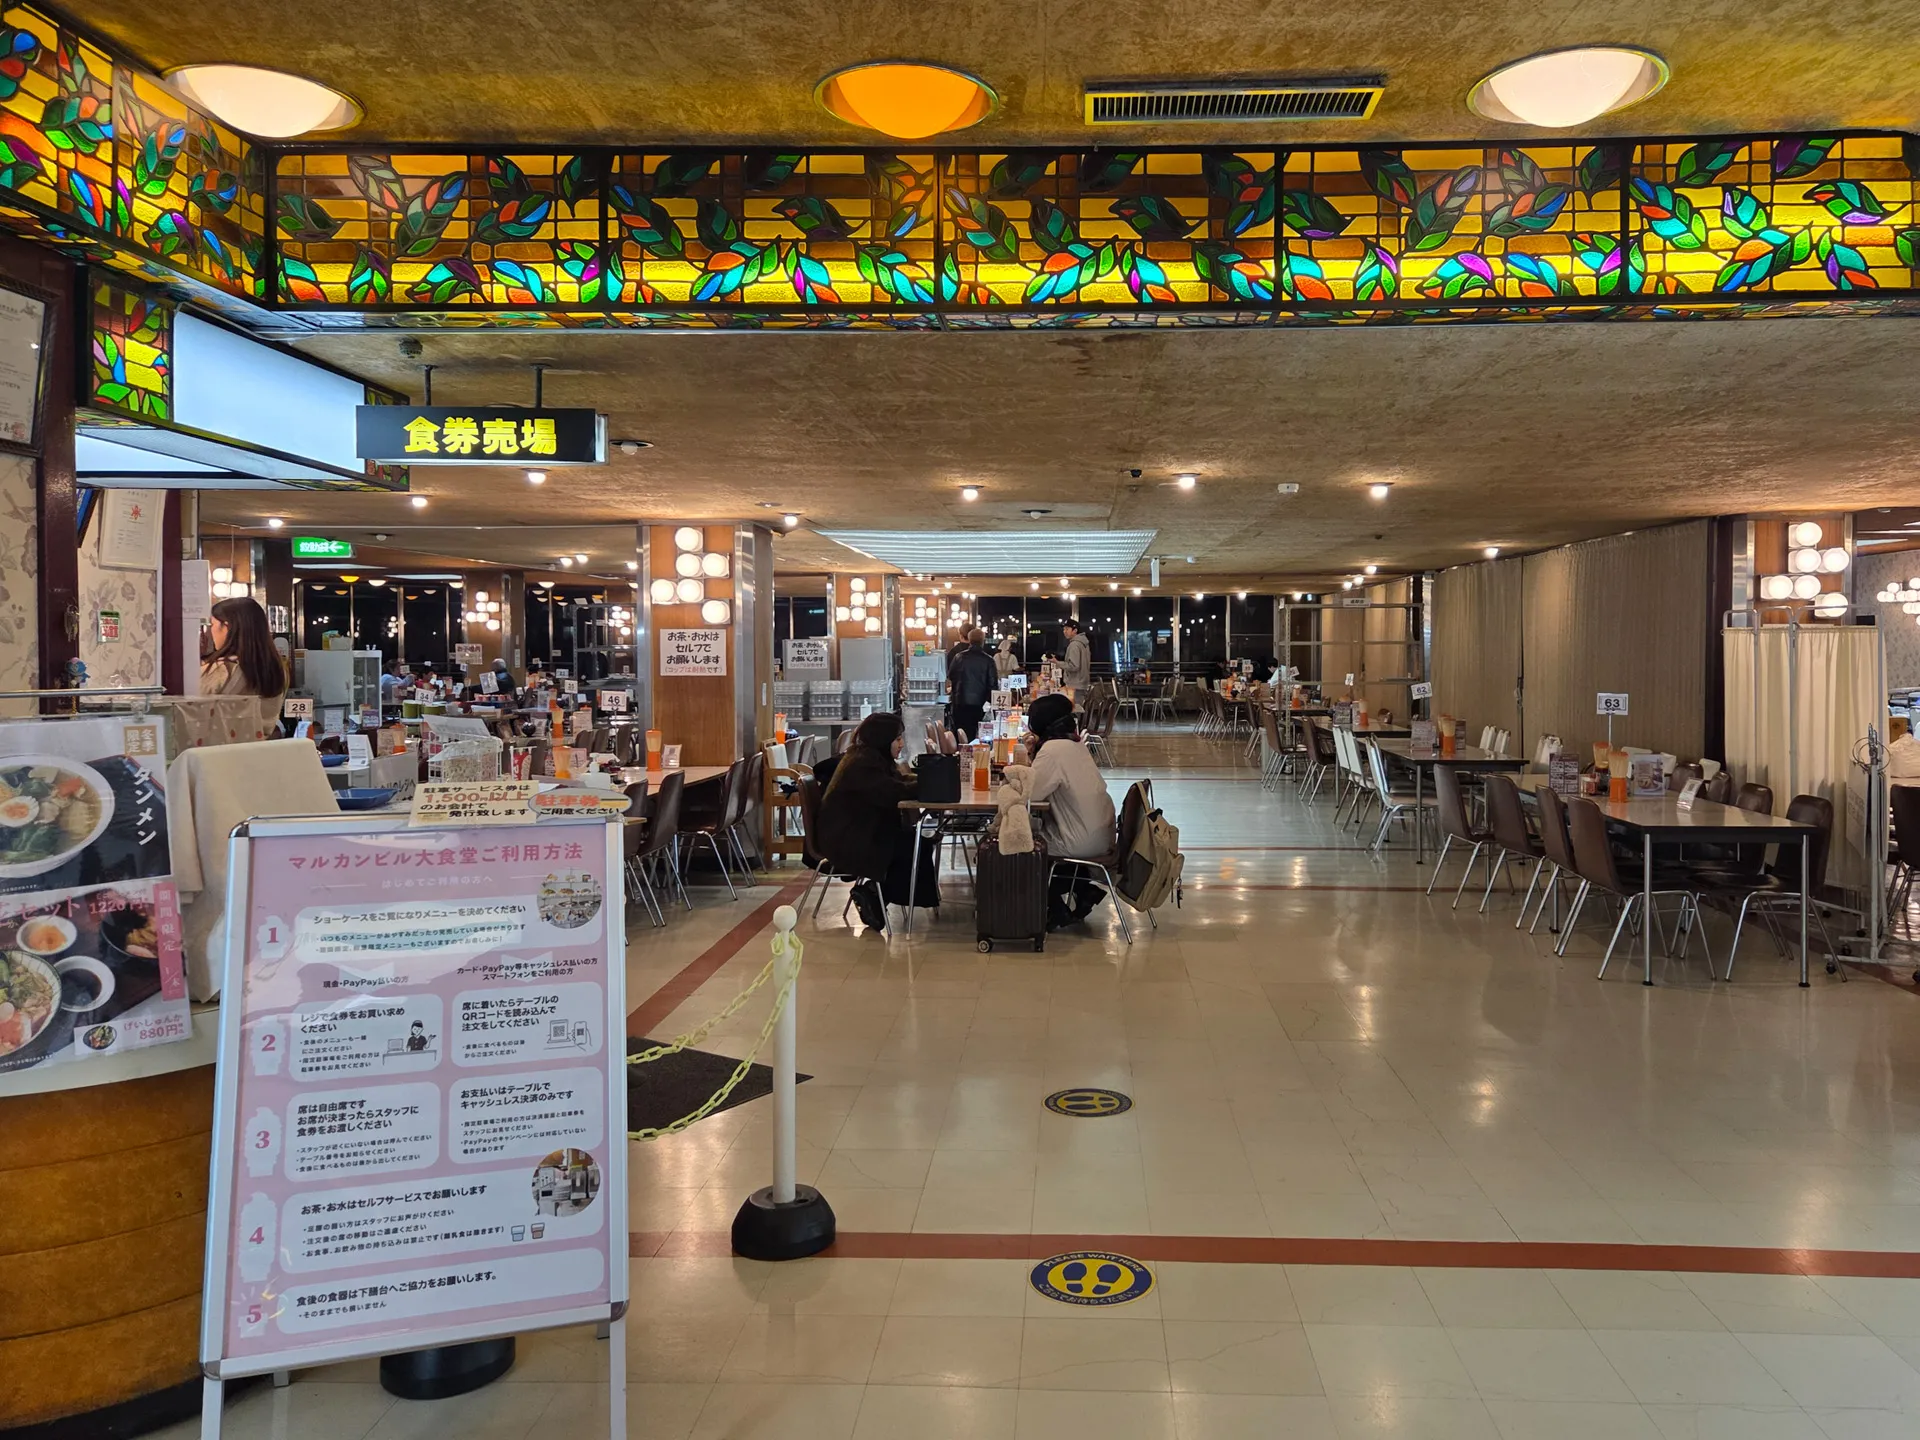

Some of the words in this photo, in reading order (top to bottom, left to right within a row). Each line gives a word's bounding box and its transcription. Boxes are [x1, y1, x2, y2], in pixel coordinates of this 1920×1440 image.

[403, 416, 557, 455] 食券売場
[667, 631, 719, 641] お茶・お水は
[675, 643, 711, 653] セルフで
[666, 654, 721, 665] お願いします
[420, 692, 430, 701] 34
[1416, 686, 1428, 695] 62
[291, 703, 306, 711] 28
[608, 695, 621, 704] 46
[996, 696, 1006, 705] 47
[1604, 698, 1620, 708] 63
[126, 730, 140, 753] 限定
[141, 728, 155, 752] 冬季
[423, 784, 531, 794] 駐車サービス券は
[425, 792, 529, 803] 1,500円以上
[535, 794, 600, 807] 駐車券
[134, 766, 157, 846] タンメン
[420, 802, 487, 810] のお会計で
[449, 808, 529, 817] 発行致します
[540, 807, 619, 815] ご用意ください
[289, 843, 583, 869] マルカンビル大食堂ご利用方法
[381, 876, 493, 889] はじめてご利用の方へ
[158, 889, 177, 951] 期間限定
[314, 905, 526, 925] ショーケースをご覧になりメニューを決めてください
[267, 927, 279, 943] 1
[457, 957, 598, 975] カード・PayPay等キャッシュレス払いの方
[323, 976, 409, 988] 現金・PayPay払いの方
[483, 968, 573, 981] スマートフォンをご利用の方
[462, 995, 559, 1011] 席に着いたらテーブルの
[301, 1007, 405, 1024] レジで食券をお買い求め
[462, 1006, 556, 1021] QRコードを読み込んで
[123, 1015, 183, 1031] げいしゅんか
[301, 1024, 337, 1033] ください
[462, 1018, 540, 1032] 注文をしてください
[139, 1025, 178, 1040] 880円
[261, 1034, 276, 1051] 2
[460, 1082, 550, 1099] お支払いはテーブルで
[297, 1100, 367, 1115] 席は自由席です
[460, 1090, 573, 1110] キャッシュレス決済のみです
[297, 1106, 419, 1126] お席が決まったらスタッフに
[296, 1120, 392, 1137] 食券をお渡しください
[255, 1130, 270, 1149] 3
[301, 1184, 488, 1215] お茶・お水はセルフサービスでお願いします
[249, 1226, 265, 1244] 4
[1043, 1253, 1085, 1267] PLEASE
[1119, 1258, 1144, 1273] HERE
[296, 1271, 497, 1307] 食後の食器は下膳台へご協力をお願いします。
[246, 1305, 262, 1324] 5
